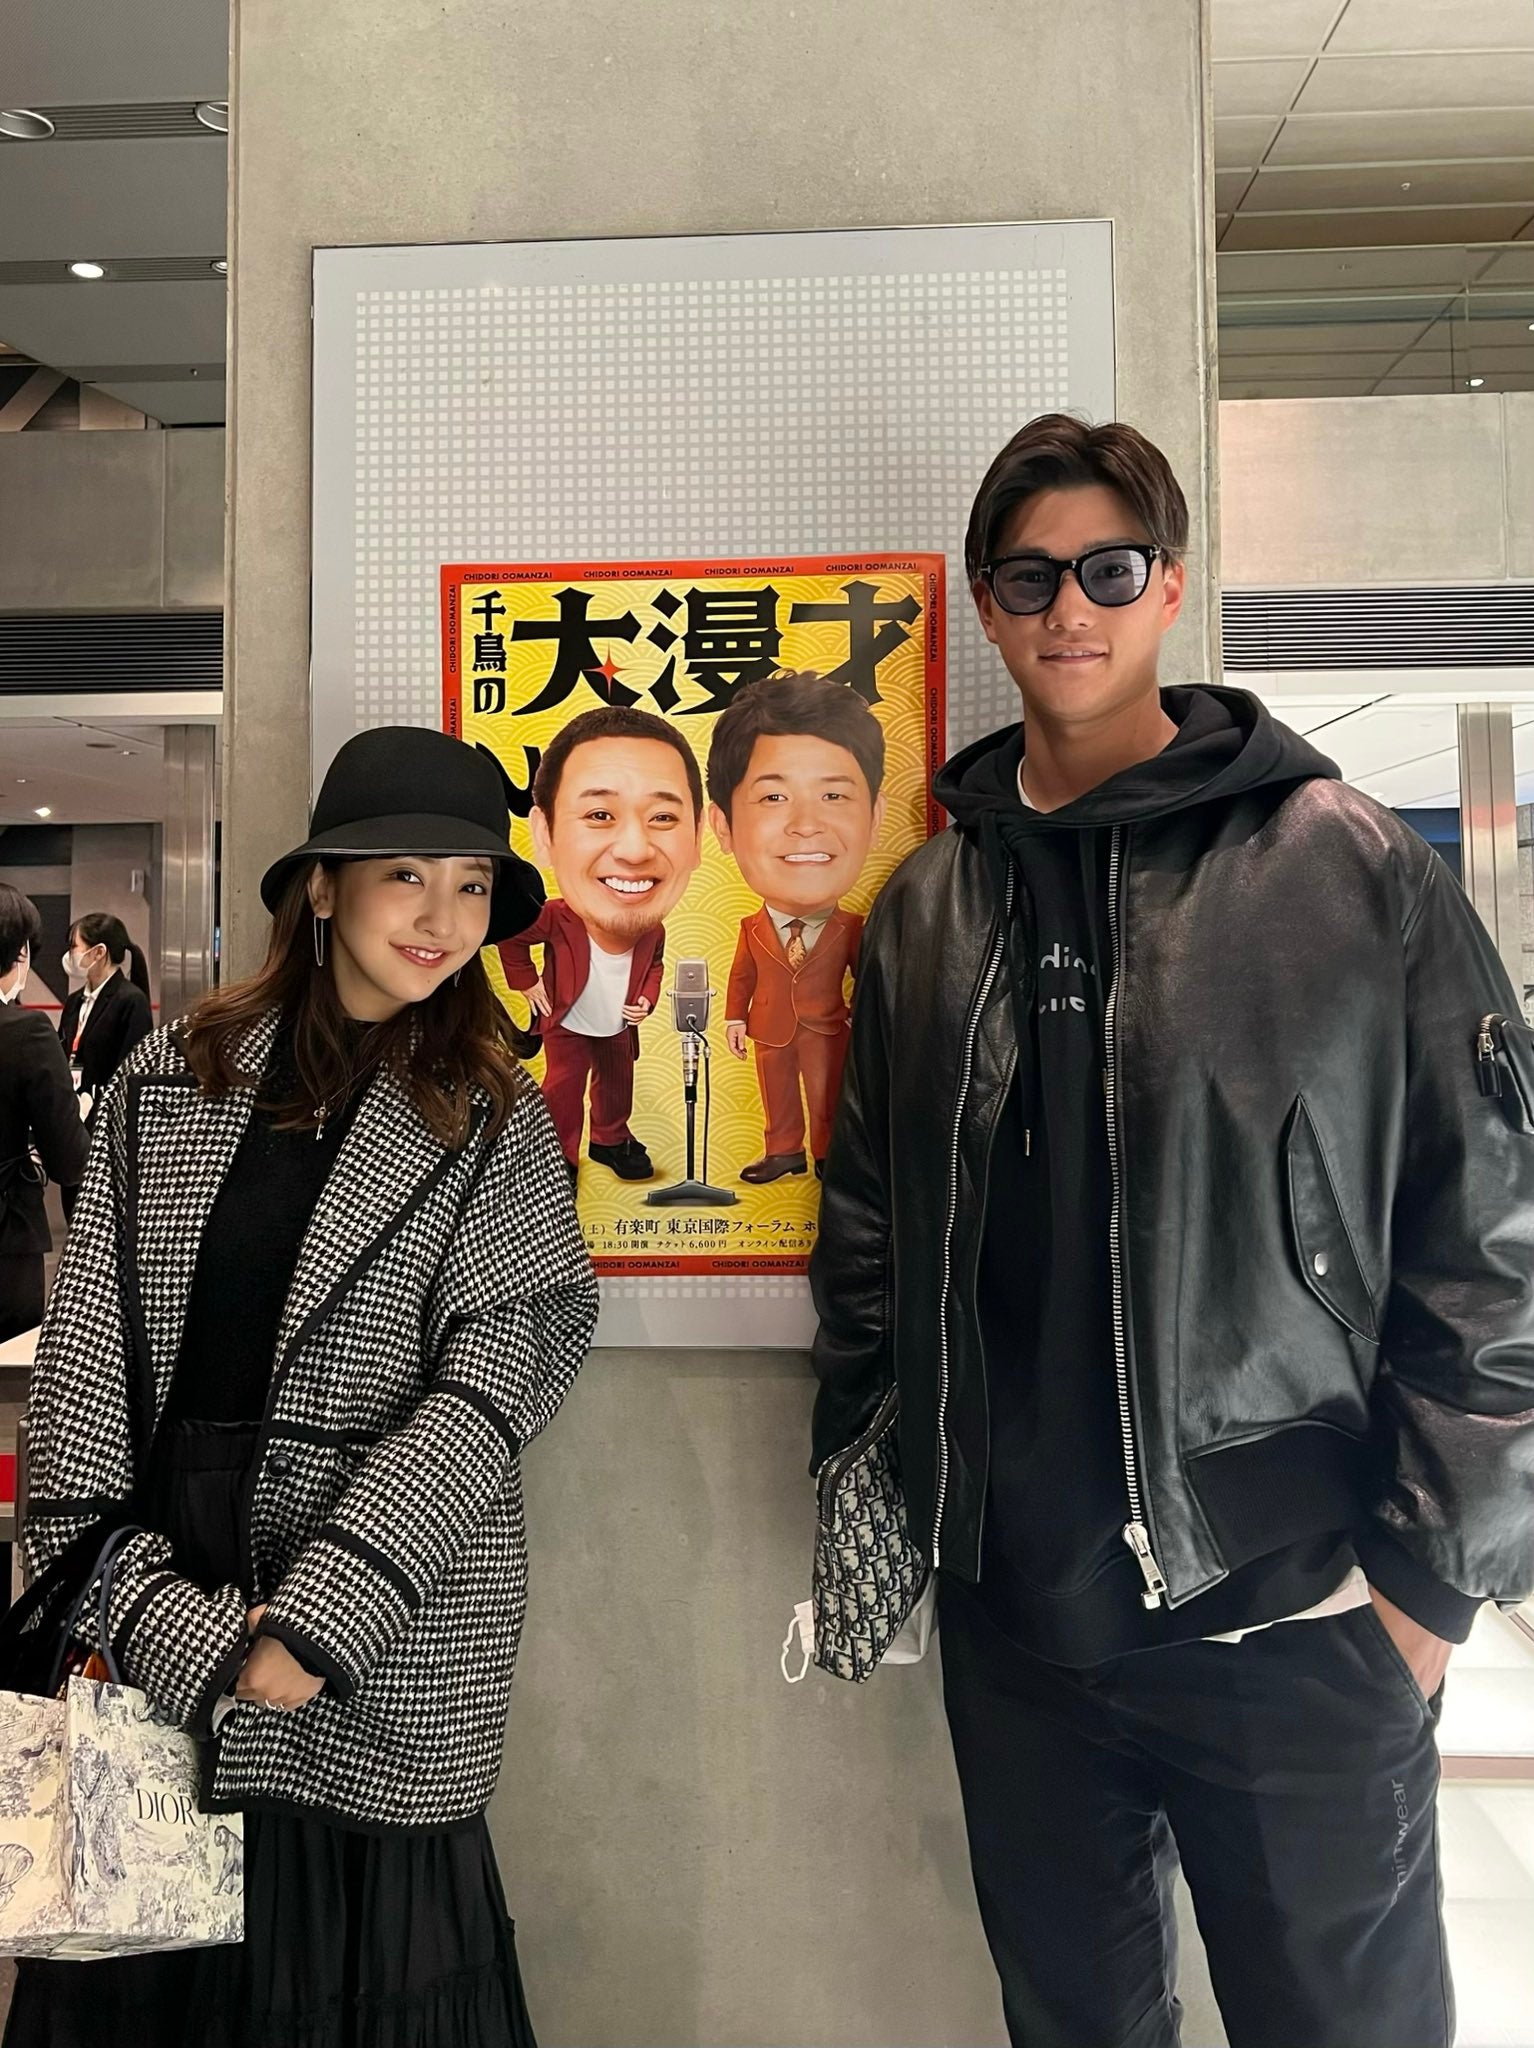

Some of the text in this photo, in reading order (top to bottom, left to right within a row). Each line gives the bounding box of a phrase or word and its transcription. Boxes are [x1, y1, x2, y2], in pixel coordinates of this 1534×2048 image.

[622, 569, 673, 577] OOMANZAI
[704, 565, 795, 576] CHIDORI OOMANZAI
[826, 562, 917, 572] CHIDORI OOMANZAI
[463, 572, 553, 581] CHIDORI OOMANZAI
[929, 572, 938, 663] CHIDORI OOMANZAI
[471, 589, 508, 715] 千鳥の
[511, 580, 923, 716] 大漫才
[614, 1218, 660, 1235] 有楽町
[665, 1217, 795, 1235] 東京国際フォーラム
[136, 1788, 197, 1827] DIOR
